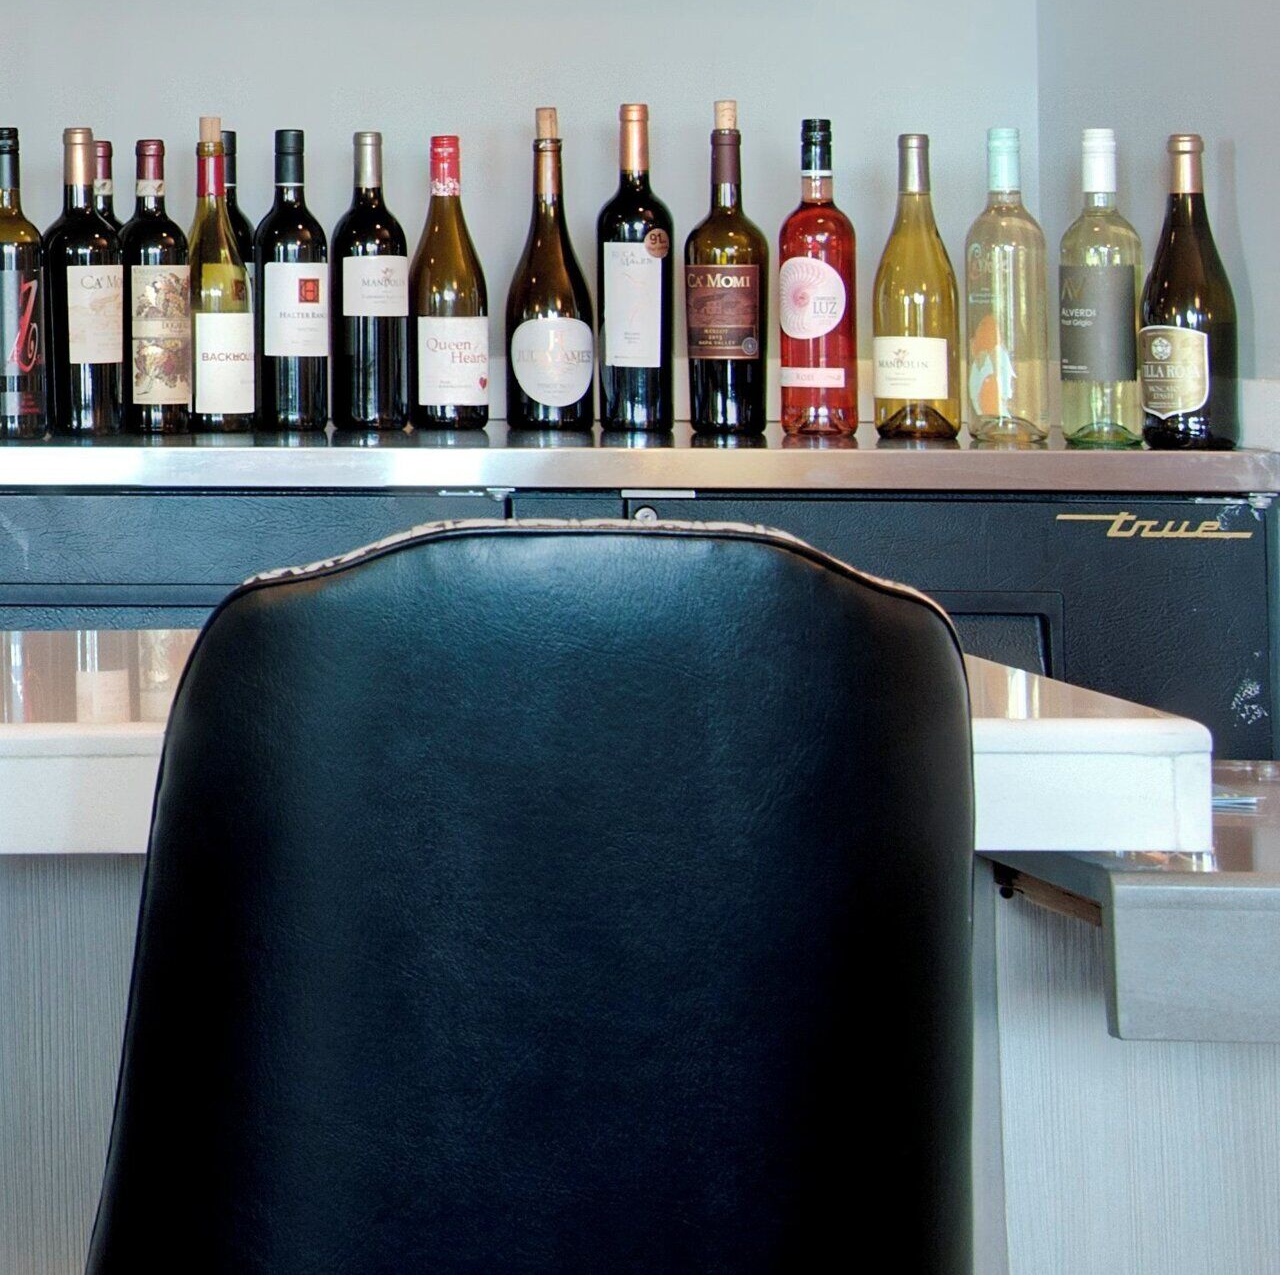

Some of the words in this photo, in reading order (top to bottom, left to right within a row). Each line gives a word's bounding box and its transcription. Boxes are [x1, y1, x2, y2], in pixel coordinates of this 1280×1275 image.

[706, 273, 751, 288] MOMI
[813, 301, 838, 315] LUZ
[426, 337, 472, 352] Queen
[451, 351, 488, 364] Hearts
[878, 360, 929, 369] MANDOLIN
[1143, 365, 1164, 378] ILLA
[1166, 365, 1200, 378] ROA
[1056, 511, 1253, 539] true
